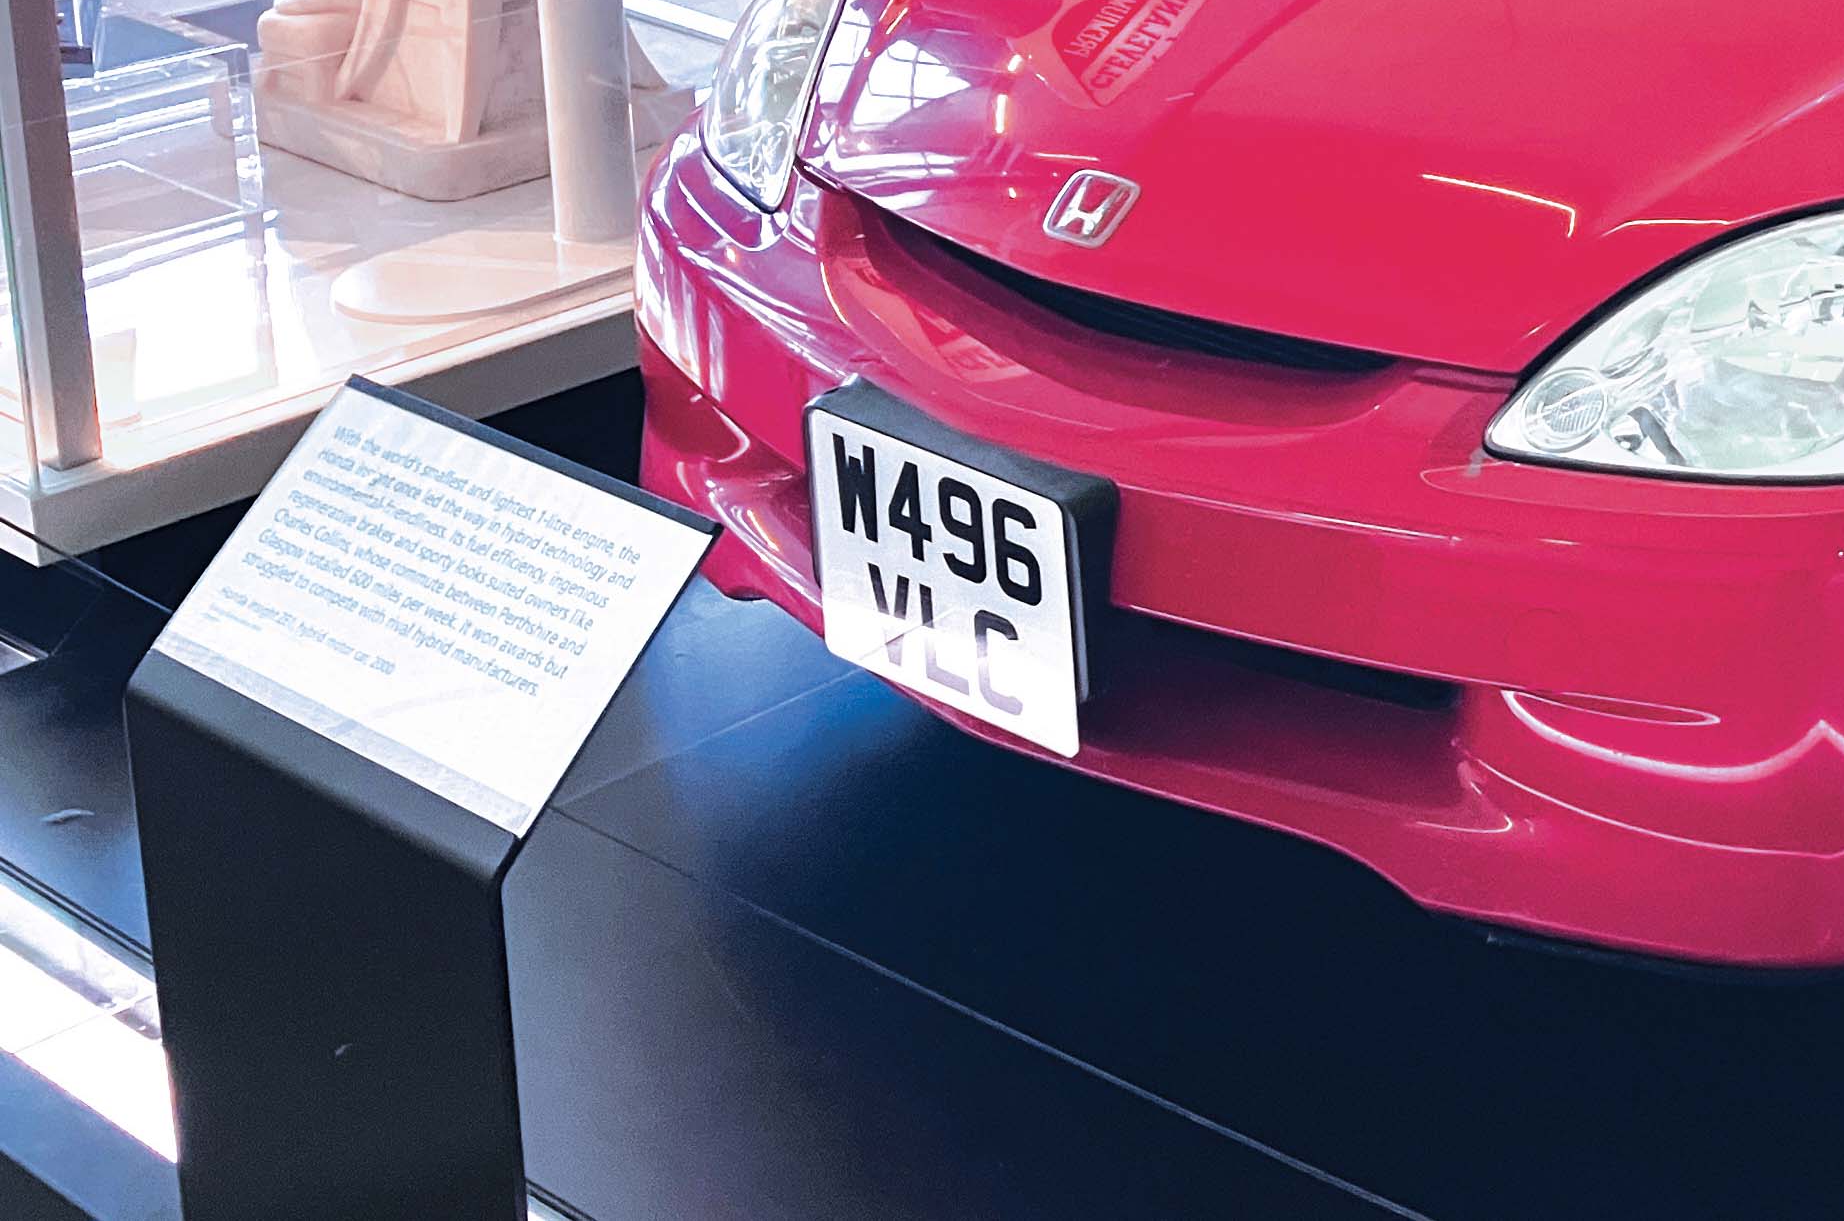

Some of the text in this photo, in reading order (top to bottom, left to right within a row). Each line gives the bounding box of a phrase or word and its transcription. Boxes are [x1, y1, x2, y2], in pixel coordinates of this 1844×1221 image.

[355, 515, 397, 544] brakes
[393, 535, 421, 554] and
[415, 546, 457, 573] sporty
[453, 557, 488, 584] looks
[485, 576, 528, 601] suited
[524, 593, 571, 621] owners
[568, 608, 594, 632] like
[421, 488, 446, 509] led
[441, 498, 464, 518] the
[462, 508, 489, 531] way
[487, 516, 502, 534] in
[500, 521, 545, 550] hybrid
[540, 541, 609, 582] technology
[607, 571, 637, 591] and
[448, 529, 467, 547] Its
[465, 534, 494, 557] fuel
[490, 548, 550, 585] efficiency,
[548, 571, 610, 609] ingenious
[466, 484, 495, 502] and
[490, 490, 537, 521] lightest
[536, 510, 573, 536] 1-litre
[571, 527, 618, 560] engine,
[618, 545, 641, 565] the
[833, 433, 1042, 606] W496
[273, 507, 315, 536] Charles
[353, 546, 392, 571] whose
[390, 562, 446, 595] commute
[444, 582, 498, 618] between
[497, 606, 559, 645] Perthshire
[558, 637, 588, 657] and
[294, 574, 311, 590] to
[308, 582, 360, 613] compete
[358, 604, 386, 624] with
[385, 616, 416, 638] rival
[411, 625, 455, 656] hybrid
[450, 648, 539, 697] manufacturers.
[370, 582, 404, 604] miles
[399, 596, 426, 613] per
[423, 605, 461, 630] week.
[458, 618, 473, 636] It
[471, 627, 500, 647] won
[498, 640, 545, 668] awards
[543, 655, 569, 680] but
[868, 563, 1023, 716] VLC
